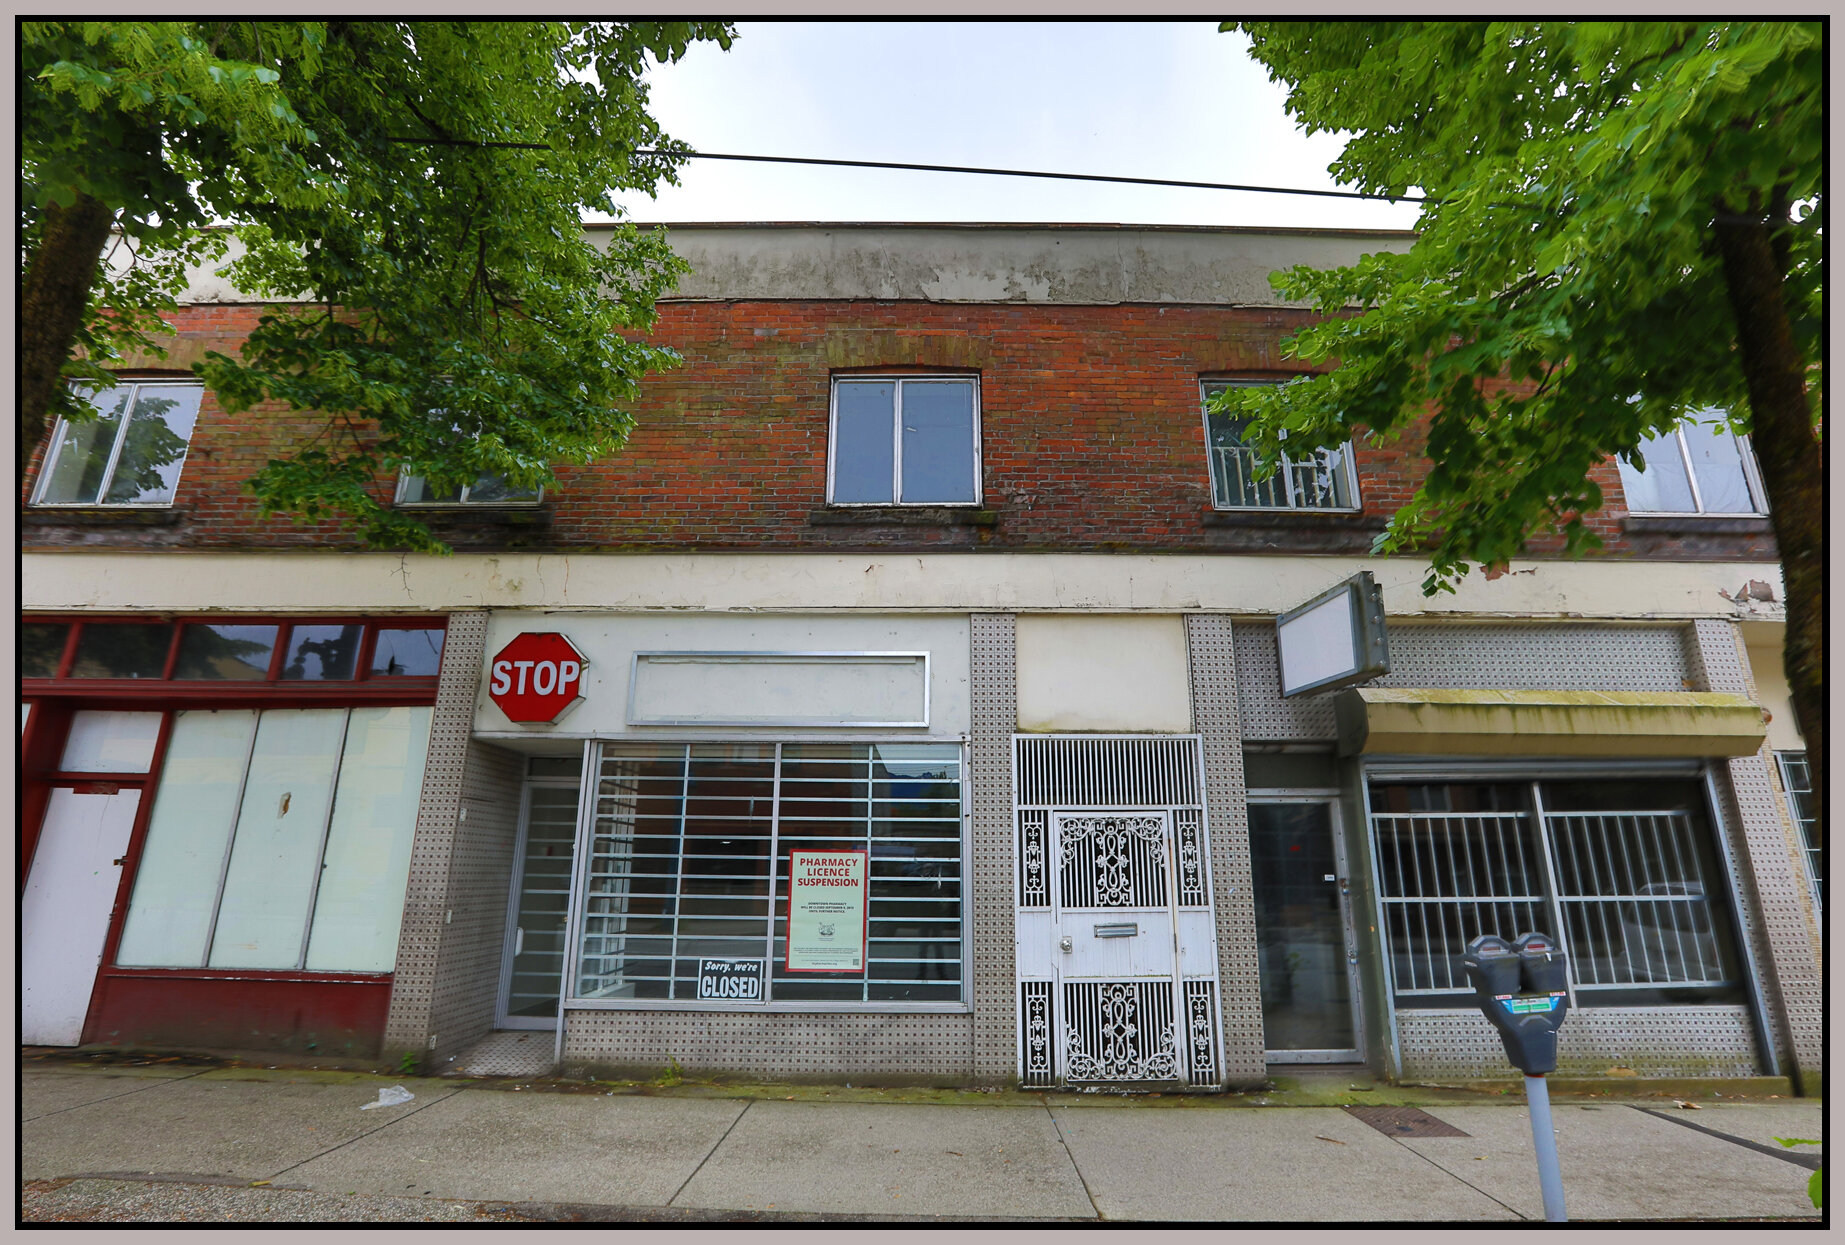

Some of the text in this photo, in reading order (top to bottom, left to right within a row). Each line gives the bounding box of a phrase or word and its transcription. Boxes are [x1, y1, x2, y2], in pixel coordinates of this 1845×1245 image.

[491, 660, 580, 695] STOP
[800, 858, 858, 867] PHARMACY
[807, 868, 850, 877] LICENCE
[797, 878, 859, 887] SUSPENSION
[705, 961, 758, 973] Sorry, we're
[701, 976, 759, 998] CLOSED
